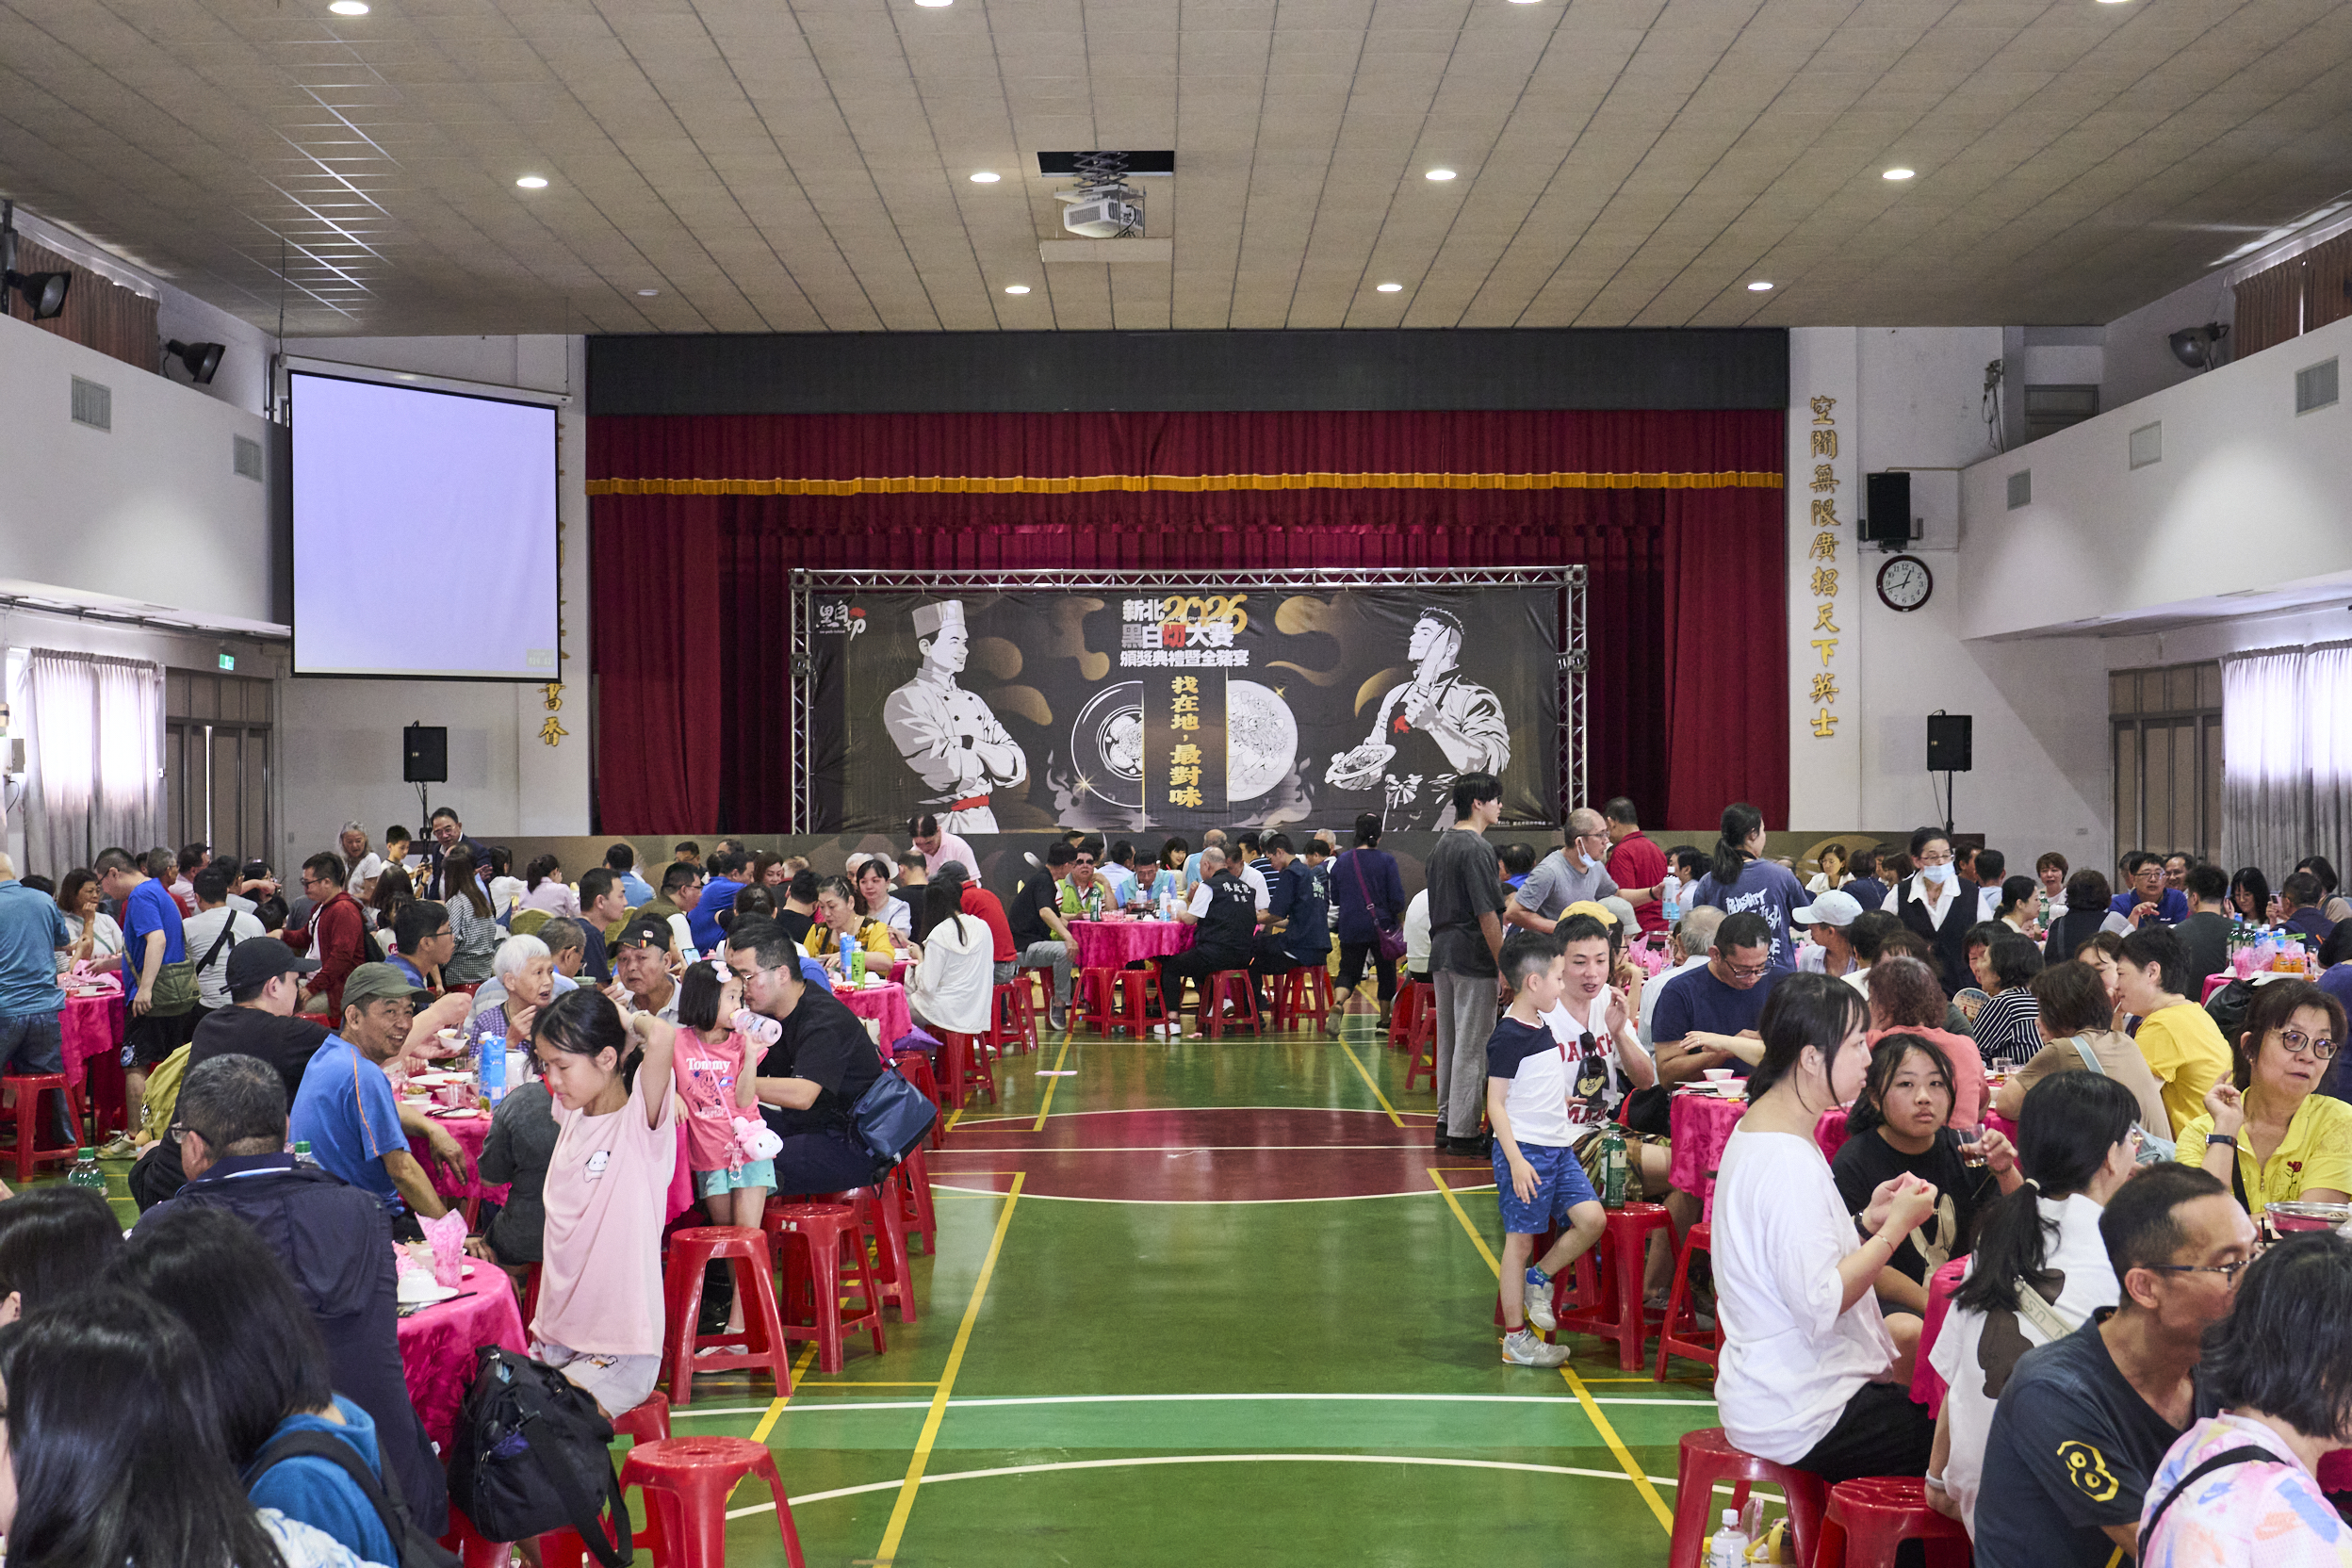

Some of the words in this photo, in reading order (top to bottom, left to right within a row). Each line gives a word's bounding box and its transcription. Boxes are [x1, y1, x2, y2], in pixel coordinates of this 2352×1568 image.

[1808, 395, 1842, 737] 空間無限廣招天下英士
[1122, 598, 1166, 622] 新北
[1157, 594, 1249, 635] 2026
[1120, 622, 1234, 649] 黑白切大賽
[1119, 649, 1250, 667] 頒獎典禮暨全豬宴
[686, 1057, 732, 1074] Tommy
